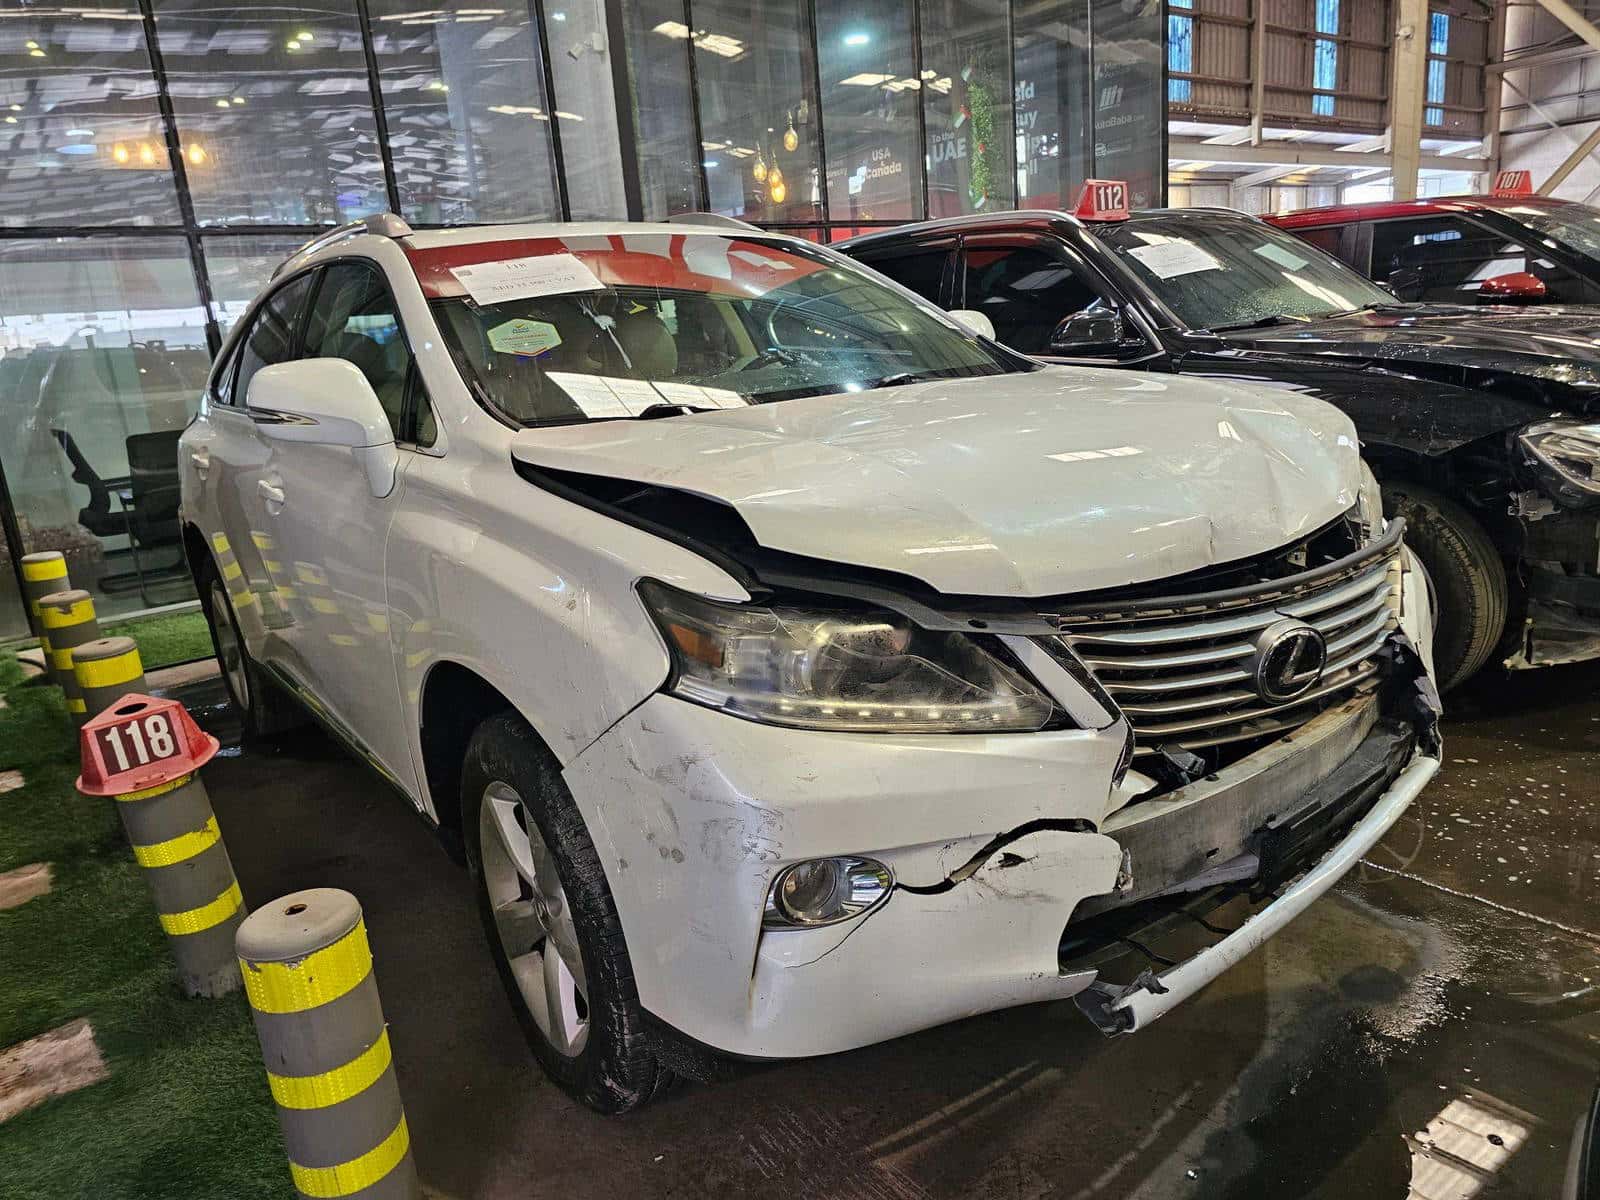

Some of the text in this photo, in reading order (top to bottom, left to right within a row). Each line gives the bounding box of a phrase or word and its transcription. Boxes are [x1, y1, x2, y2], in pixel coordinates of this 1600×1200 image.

[872, 146, 891, 161] USA
[931, 137, 967, 163] UAE
[1500, 172, 1521, 189] 101
[1098, 185, 1123, 210] 112
[104, 714, 175, 771] 118
